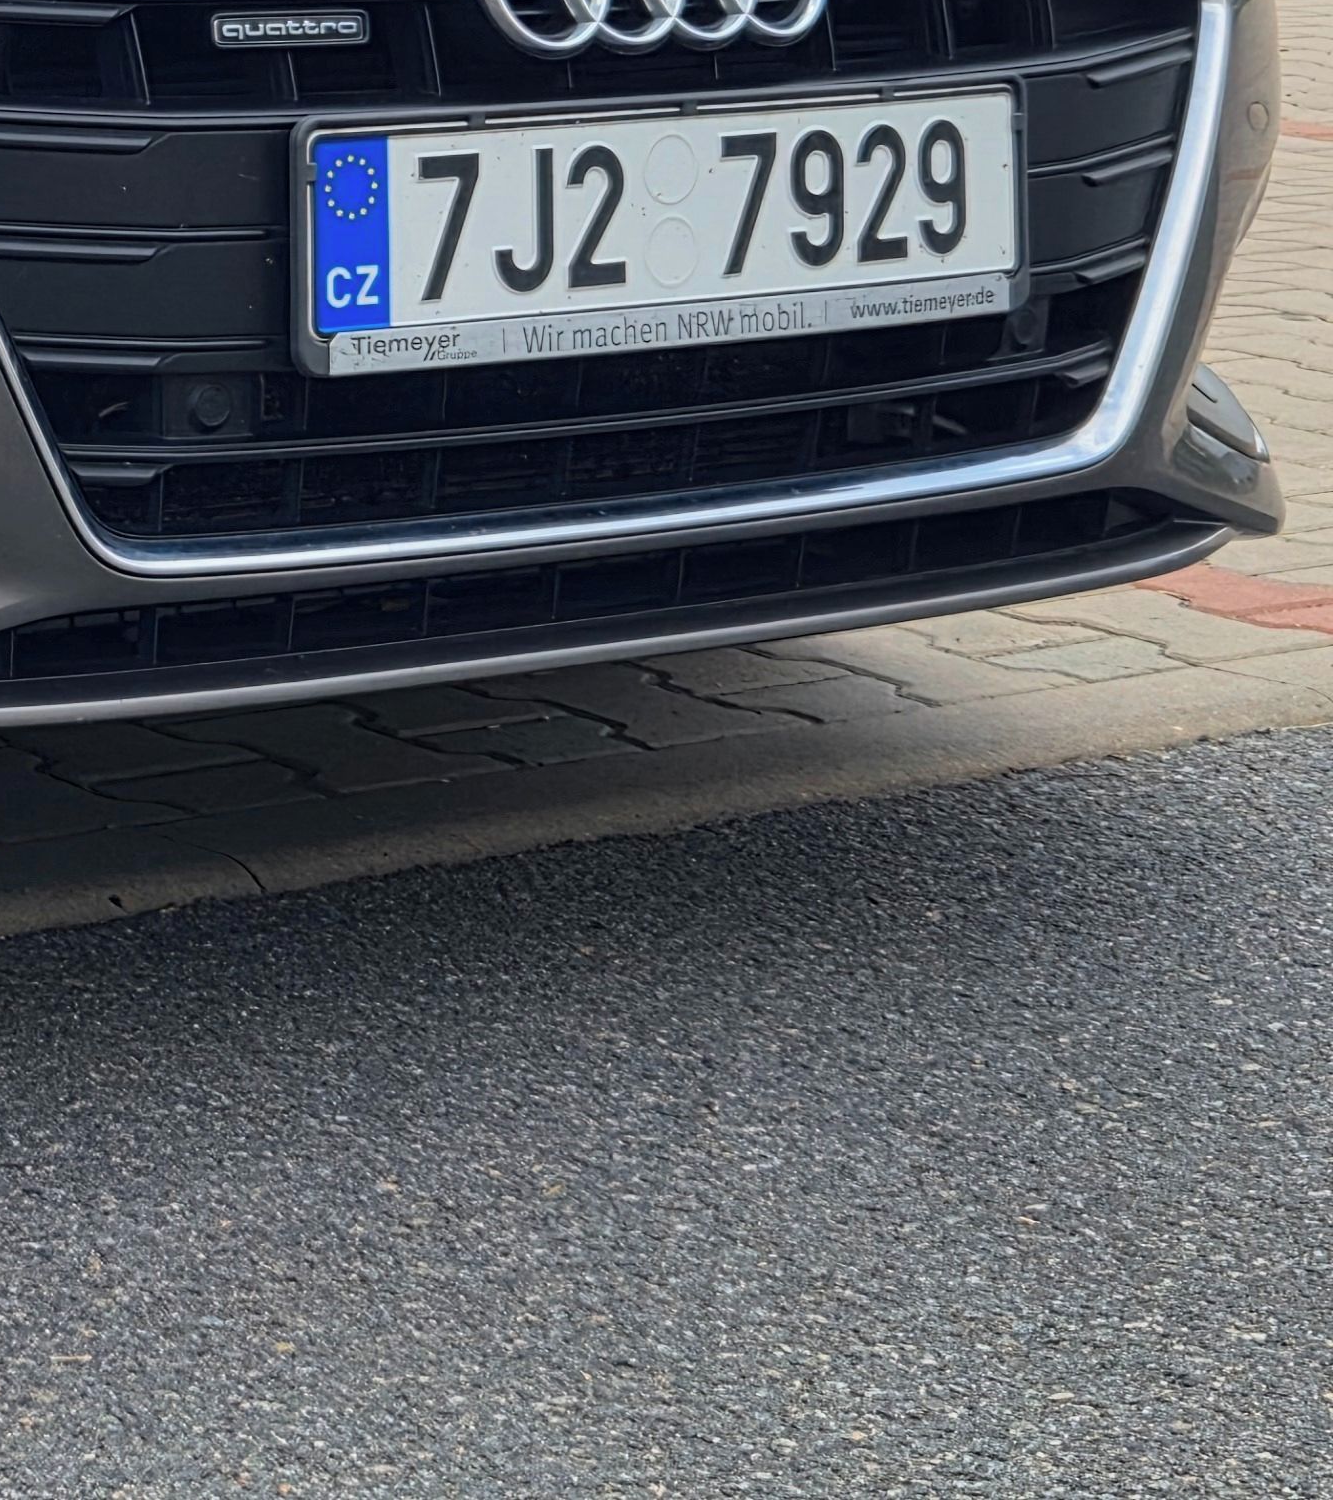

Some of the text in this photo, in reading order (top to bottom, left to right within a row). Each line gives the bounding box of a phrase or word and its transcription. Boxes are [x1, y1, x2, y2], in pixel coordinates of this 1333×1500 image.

[222, 20, 358, 40] quattro
[417, 119, 967, 301] 7J2 7929
[326, 264, 379, 308] CZ
[850, 286, 995, 319] www.tiemeyer.de
[523, 323, 564, 353] Wir
[572, 316, 667, 350] machen
[739, 301, 812, 334] mobil.
[351, 331, 460, 361] Tiemeyer
[437, 348, 478, 361] Gruppe
